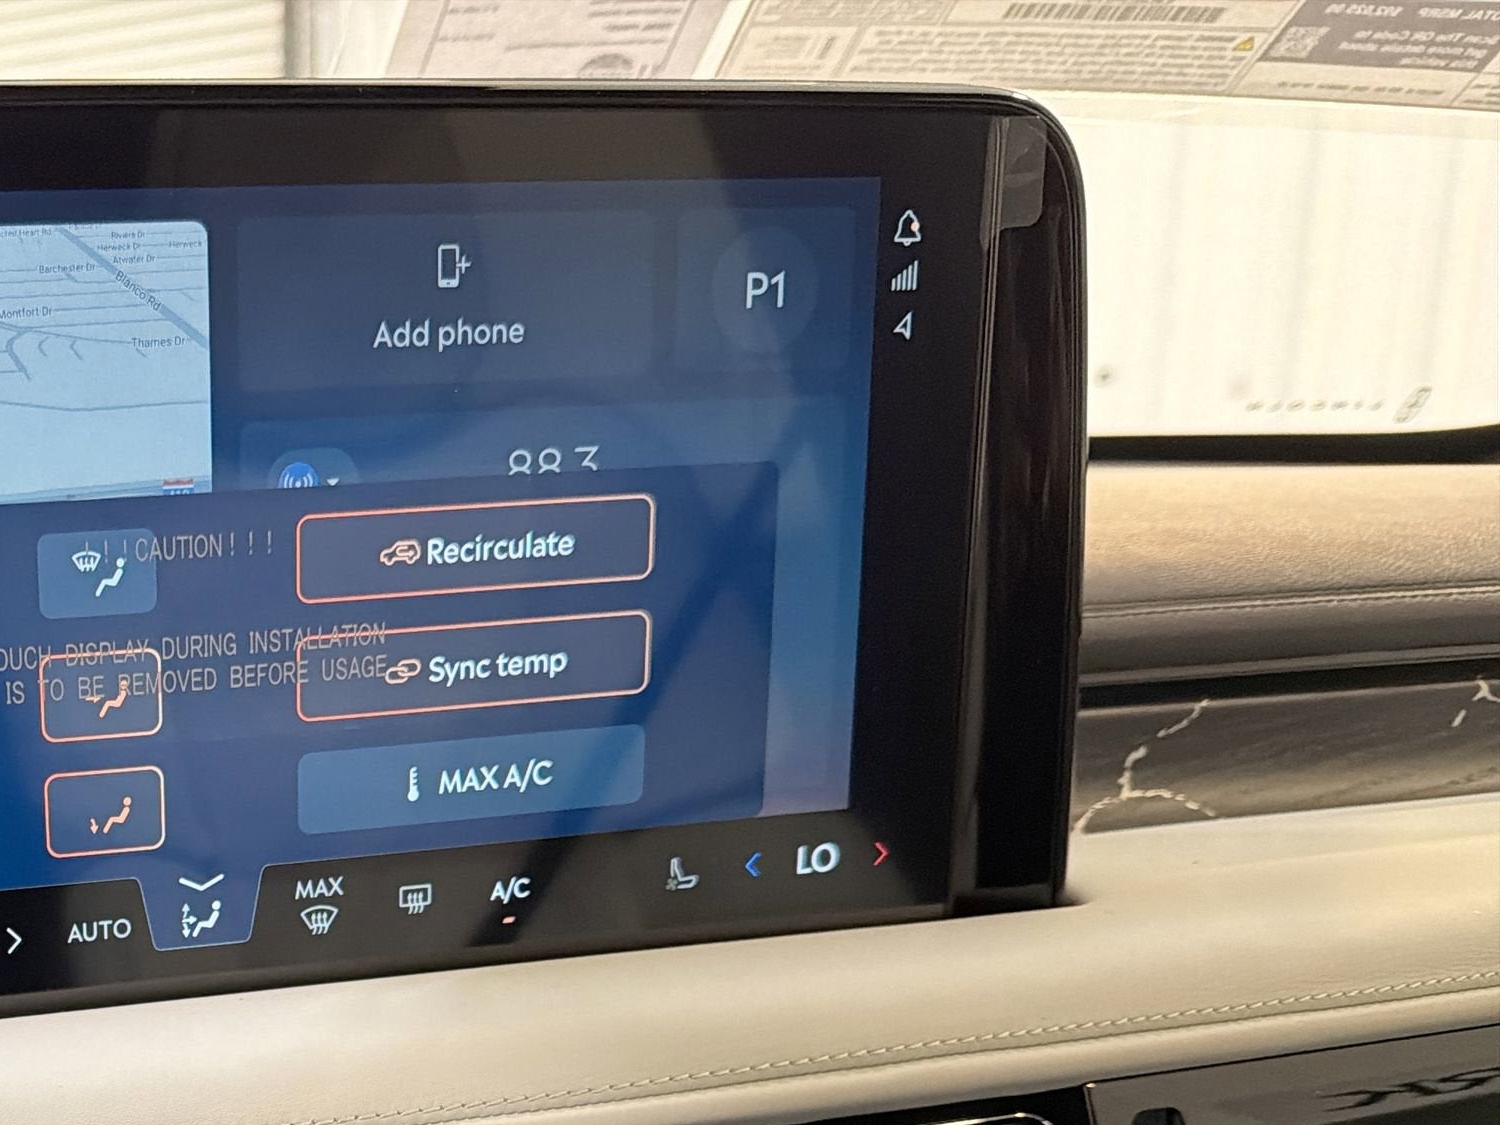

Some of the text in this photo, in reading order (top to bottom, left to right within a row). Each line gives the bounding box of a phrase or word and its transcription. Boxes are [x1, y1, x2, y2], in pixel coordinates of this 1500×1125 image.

[38, 263, 96, 275] Barchester Dr
[115, 270, 162, 312] Blanco Rd
[744, 271, 786, 310] P1
[41, 307, 52, 316] Dr
[131, 335, 185, 349] Thames Dr
[373, 317, 525, 353] Add phone
[426, 530, 576, 566] Recirculate
[65, 637, 149, 668] DISPLAY
[162, 632, 237, 661] DURING
[249, 622, 386, 653] INSTALLATION
[6, 681, 25, 705] IS
[78, 675, 105, 700] BE
[118, 667, 217, 697] REMOVED
[230, 660, 309, 690] BEFORE
[321, 654, 387, 682] USAGE
[428, 650, 569, 687] Sync temp
[438, 759, 554, 795] MAX A/C
[796, 841, 841, 875] LO
[294, 876, 344, 901] MAX
[489, 876, 532, 905] A/C
[67, 918, 132, 945] AUTO
